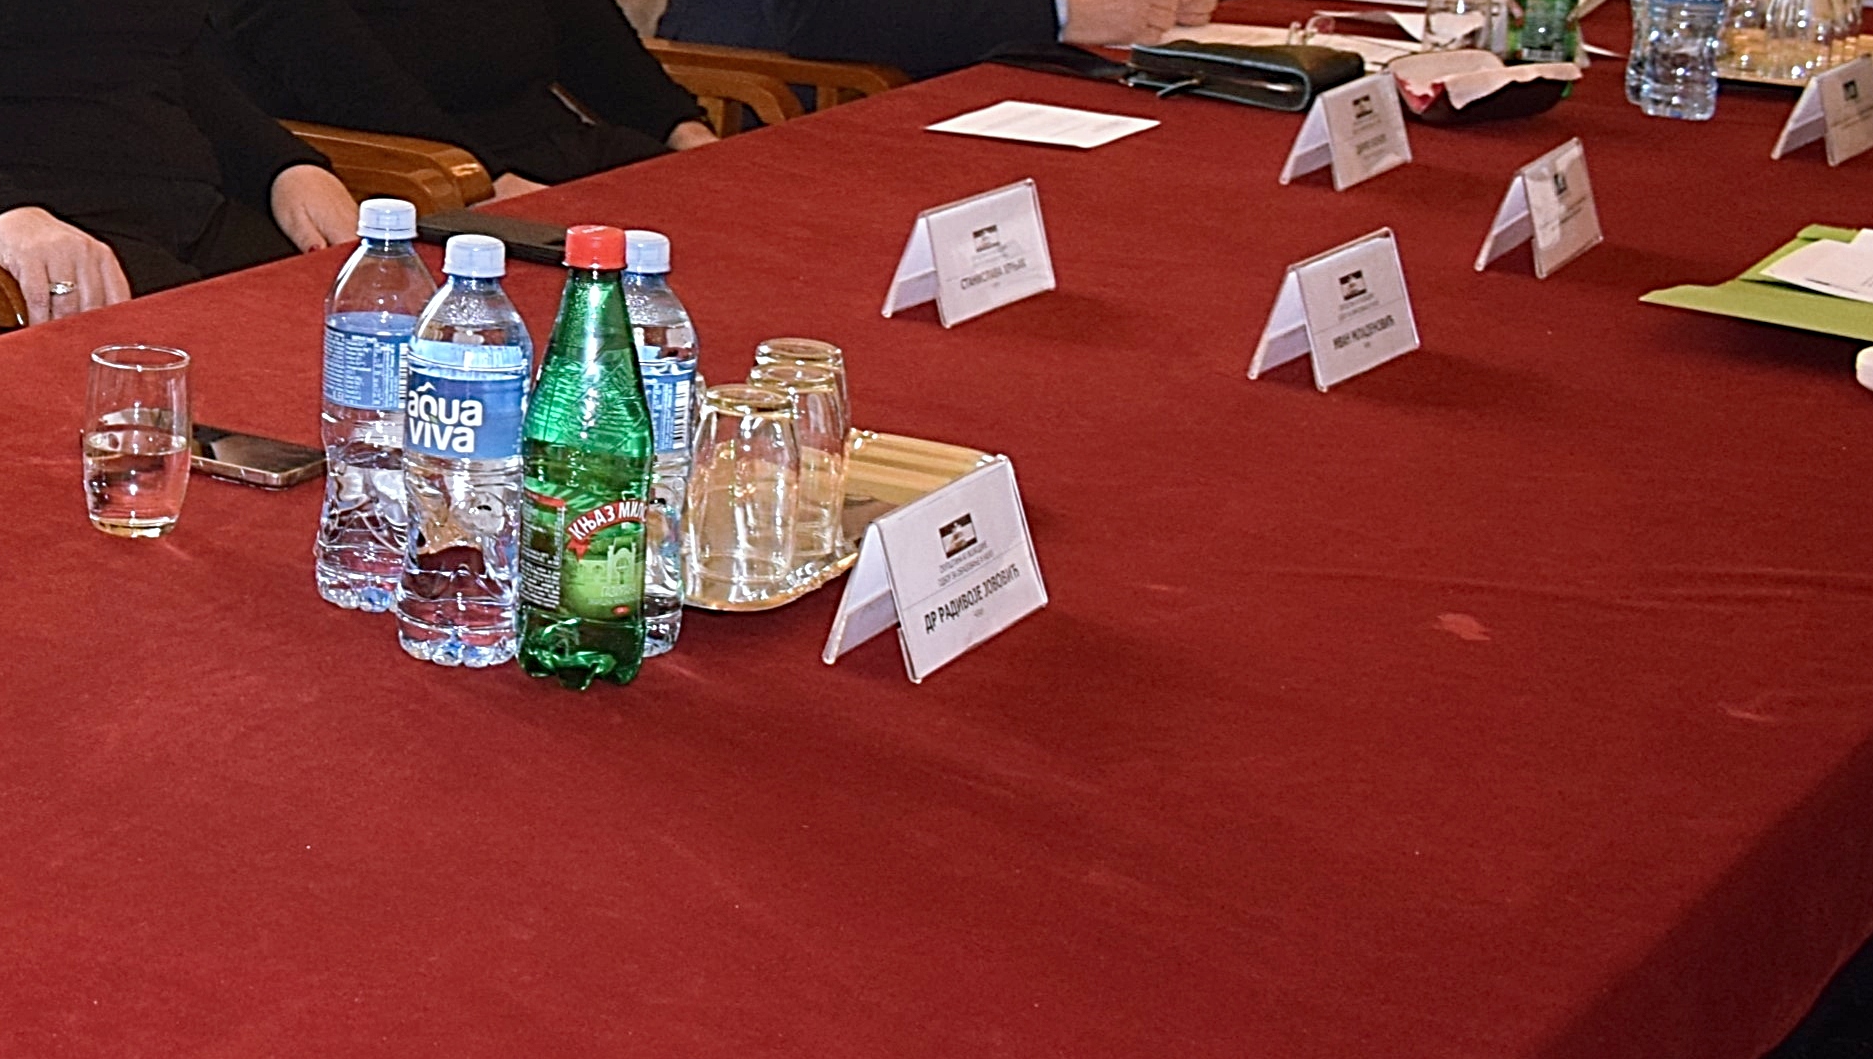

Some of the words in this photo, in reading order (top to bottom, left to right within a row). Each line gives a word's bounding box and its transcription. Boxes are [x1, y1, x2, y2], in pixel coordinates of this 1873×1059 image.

[408, 389, 483, 427] aqua
[409, 418, 475, 453] viva
[568, 505, 616, 540] КЊАЗ
[924, 611, 937, 635] ДР
[938, 585, 983, 623] РАДИВОЈЕ
